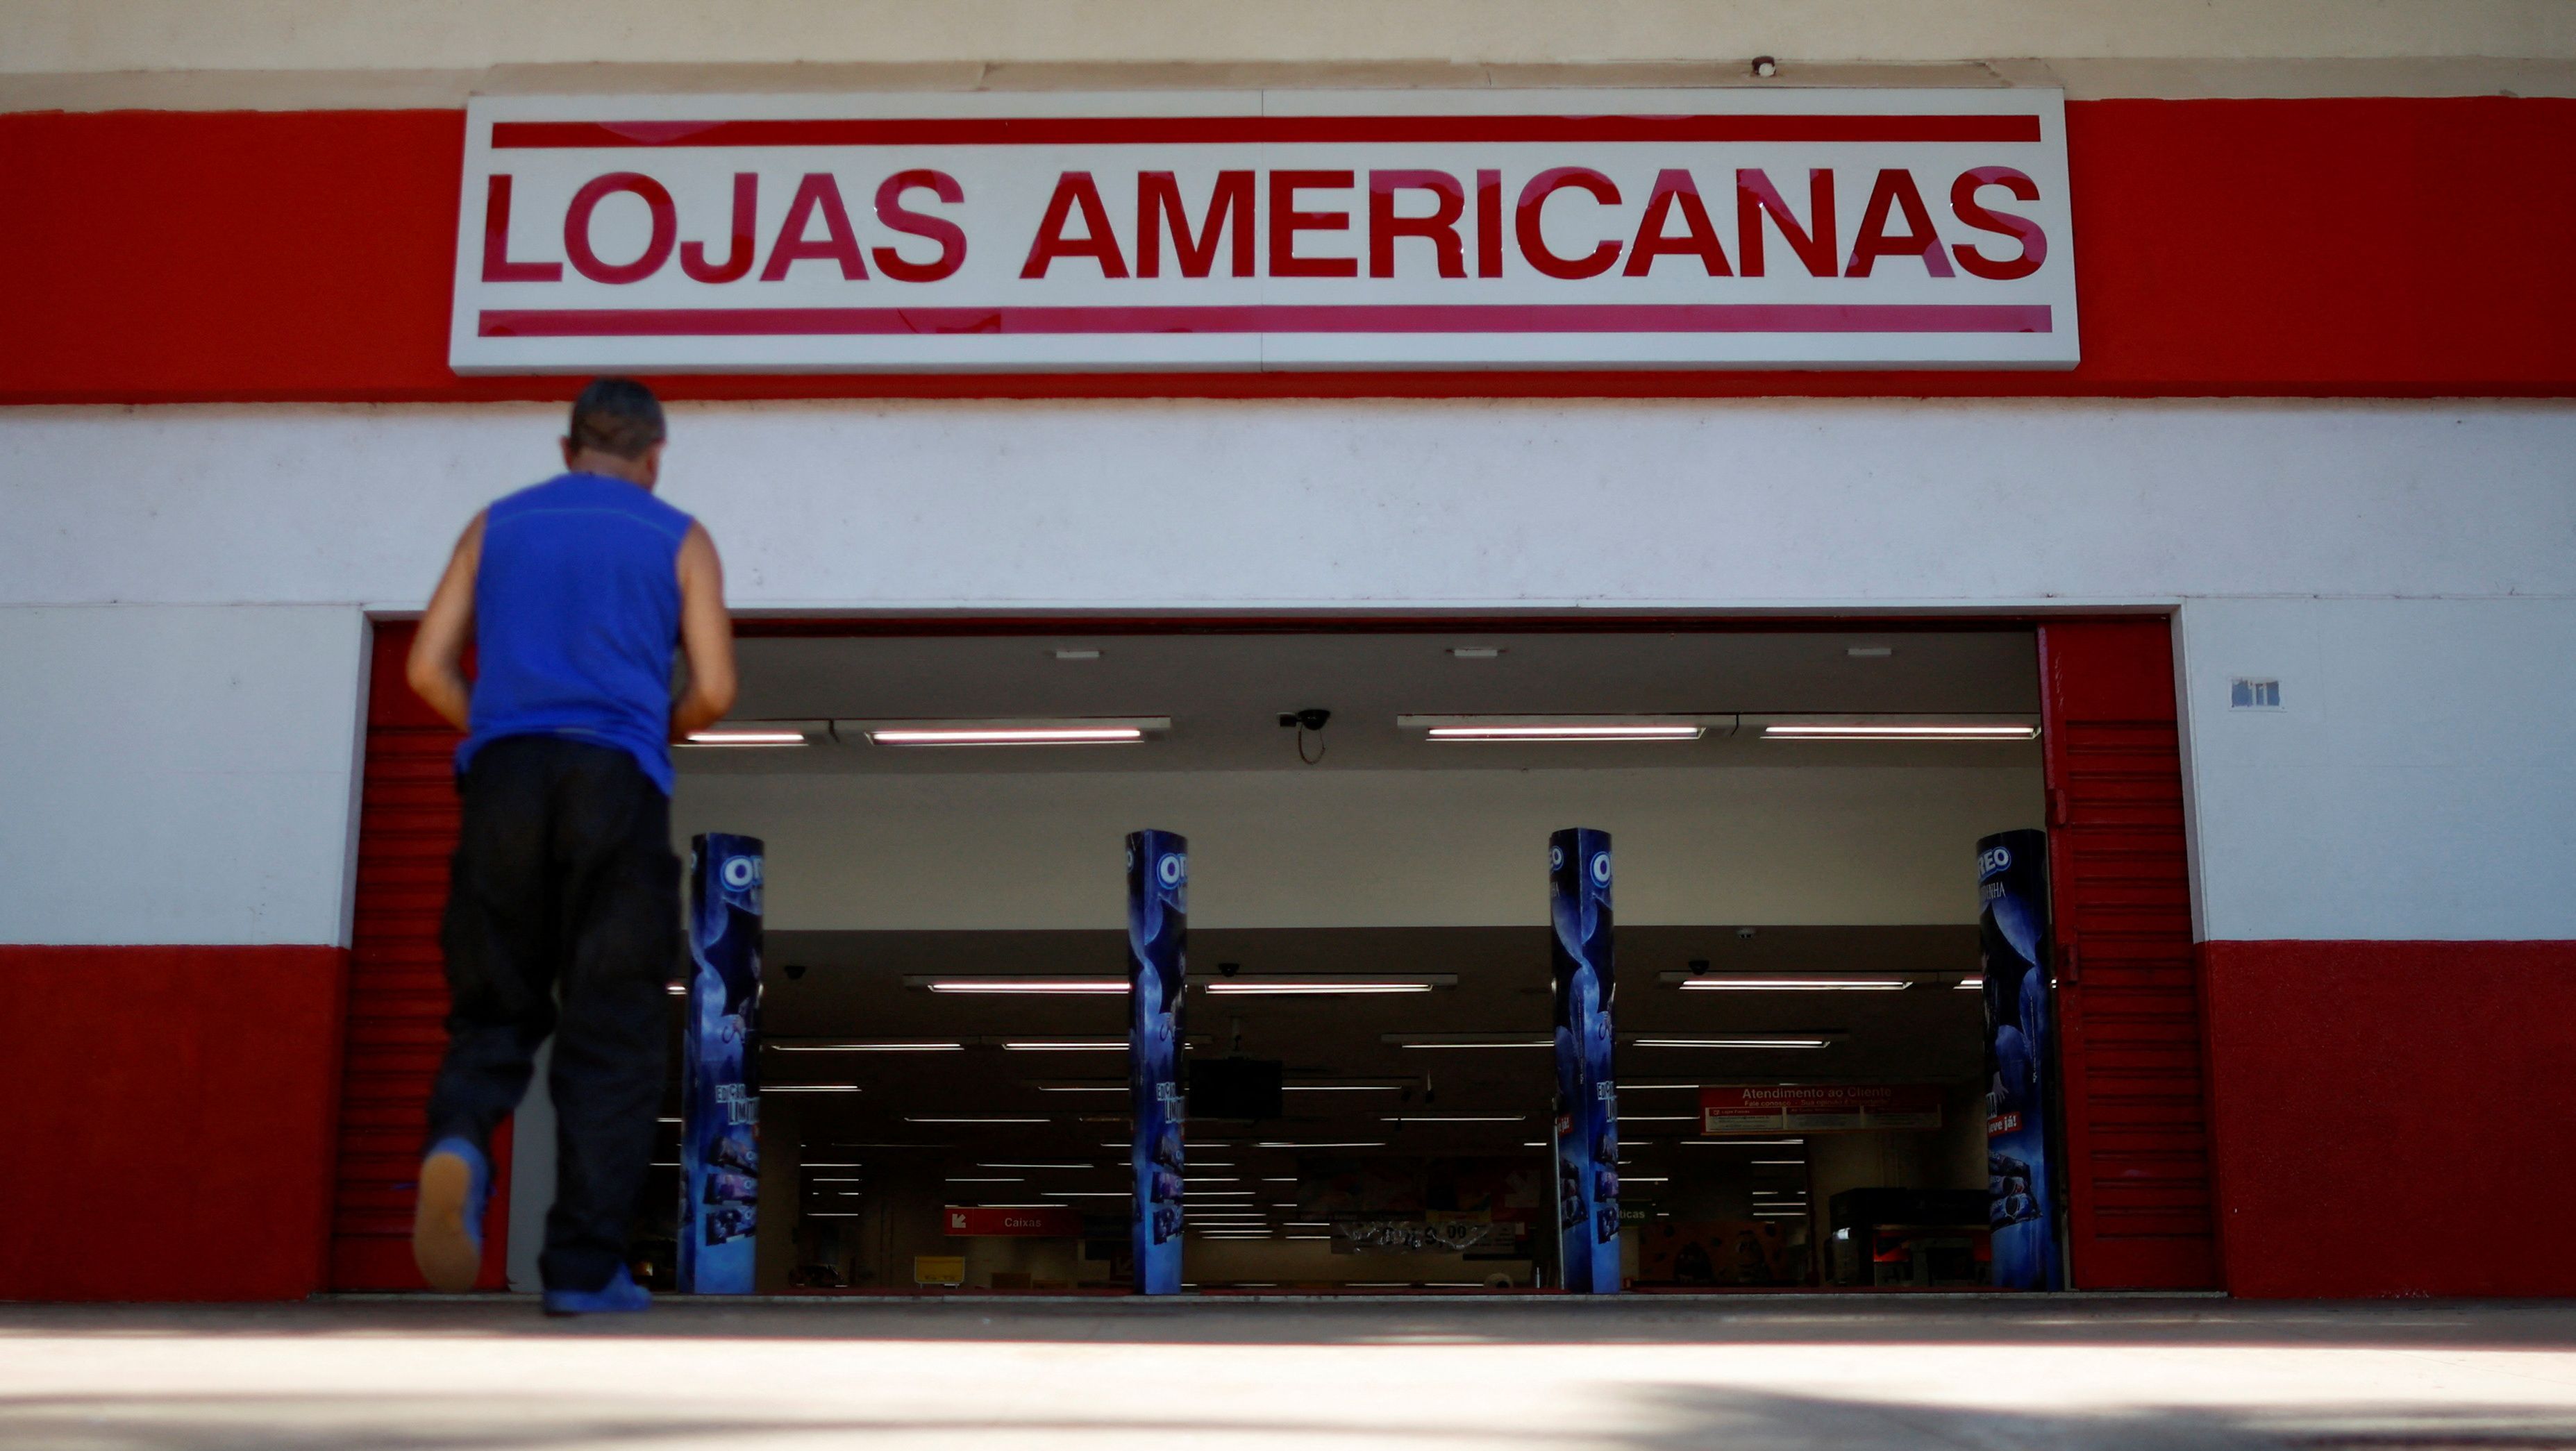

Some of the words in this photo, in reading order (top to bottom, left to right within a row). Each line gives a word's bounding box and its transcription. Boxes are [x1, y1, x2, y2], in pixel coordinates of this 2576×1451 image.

[481, 169, 967, 284] LOJAS
[1019, 166, 2048, 280] AMERICANAS
[1742, 1088, 1824, 1099] Atendimento
[1828, 1089, 1843, 1098] ao
[1847, 1087, 1892, 1098] Cliente
[1004, 1217, 1042, 1227] Caixas
